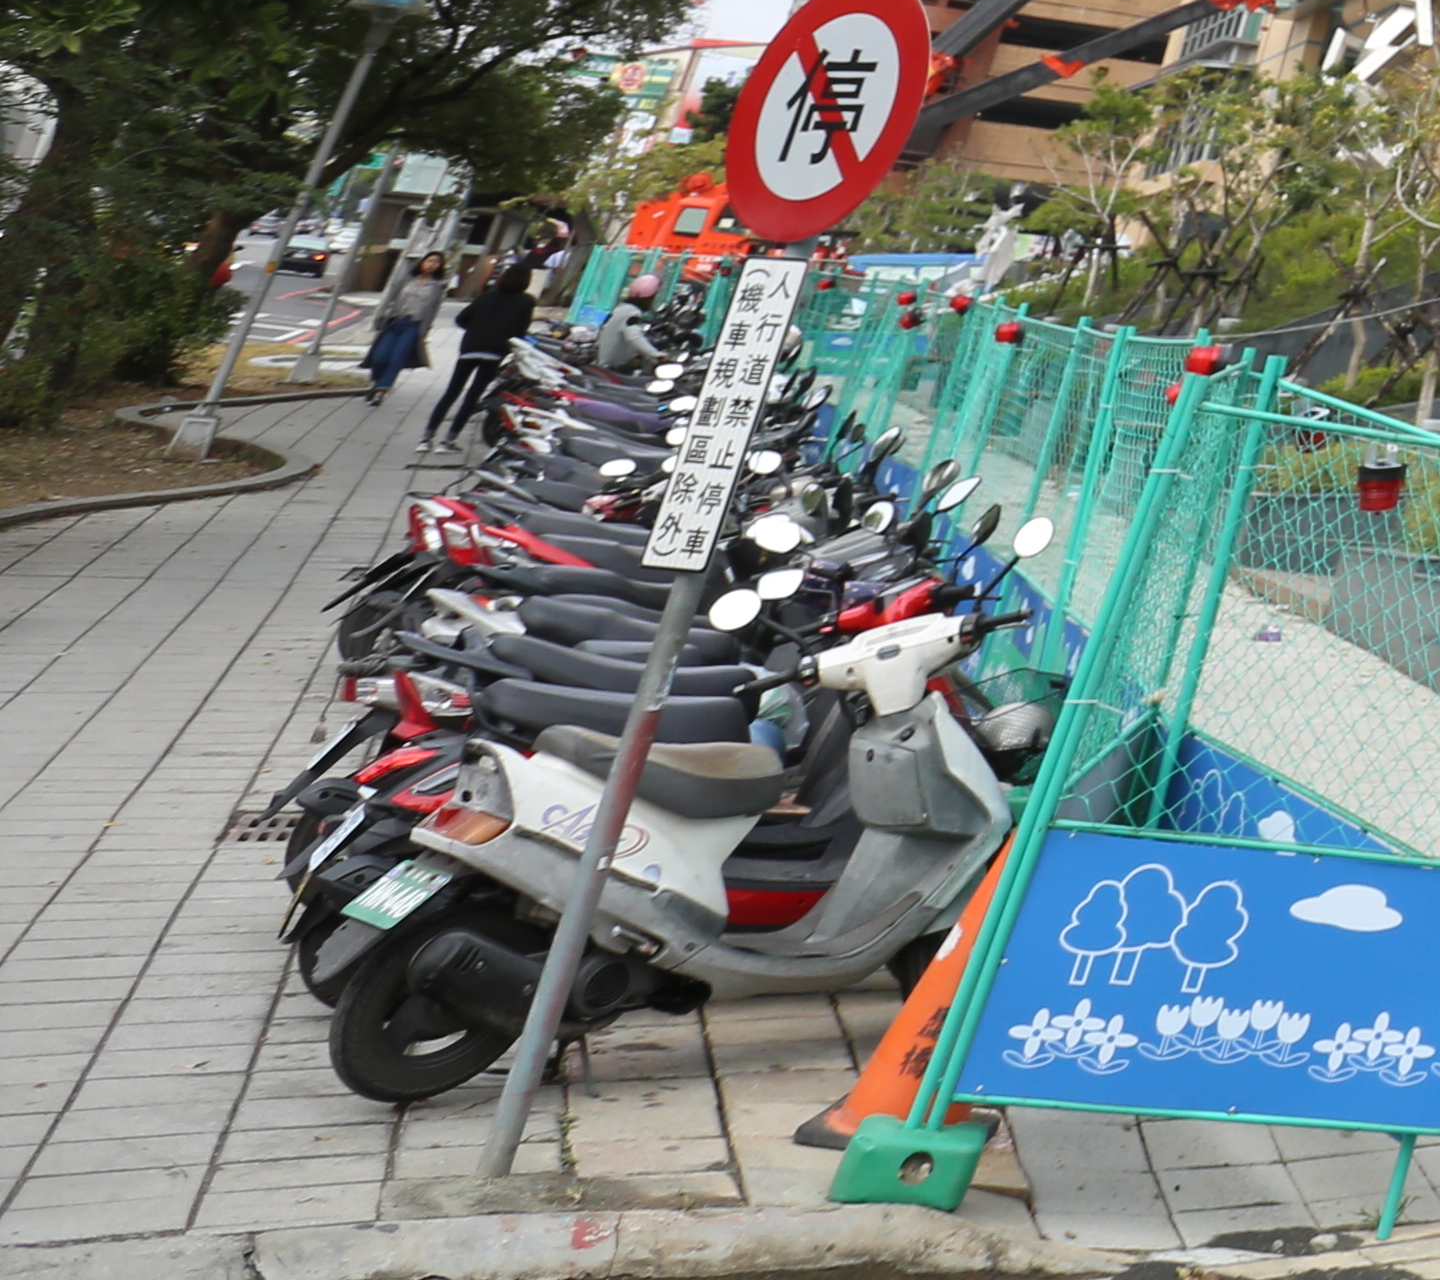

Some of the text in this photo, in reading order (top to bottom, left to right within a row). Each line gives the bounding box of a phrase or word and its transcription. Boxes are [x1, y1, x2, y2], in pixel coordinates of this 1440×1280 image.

[778, 48, 878, 165] 停
[680, 271, 791, 559] 人行道禁止停車
